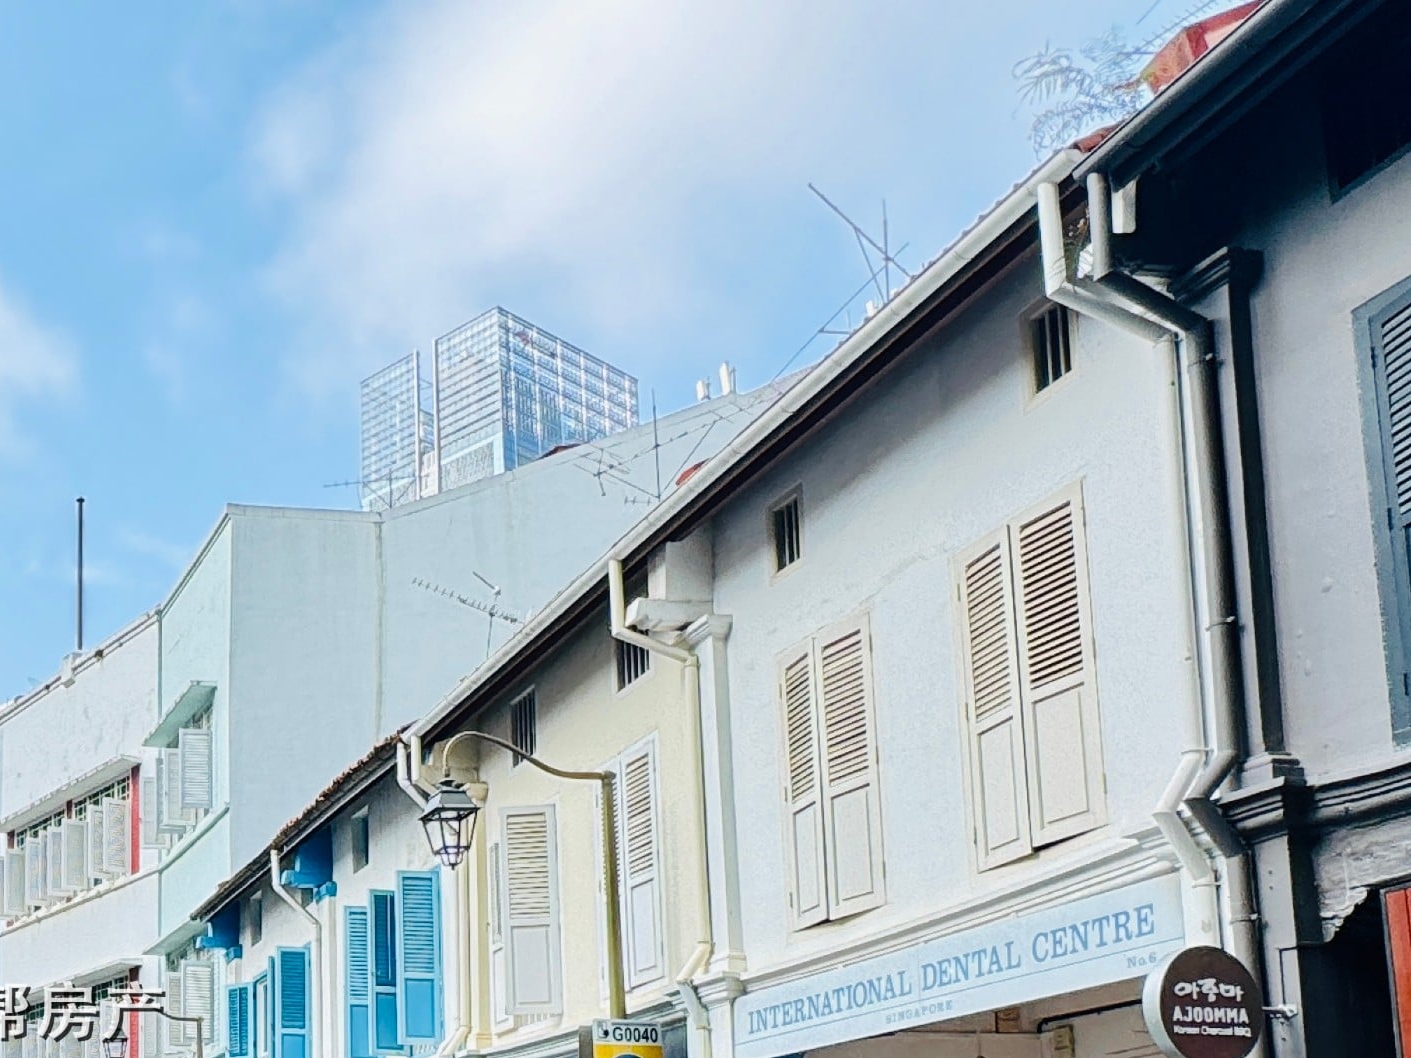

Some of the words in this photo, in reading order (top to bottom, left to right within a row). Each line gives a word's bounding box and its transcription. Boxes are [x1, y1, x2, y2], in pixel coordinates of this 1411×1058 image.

[748, 970, 912, 1035] INTERNATIONAL
[920, 940, 1021, 992] DENTAL
[1032, 903, 1155, 963] CENTRE
[1174, 977, 1244, 1002] 아줌마
[886, 999, 952, 1024] SINGAPORE
[1173, 1005, 1249, 1024] AJOOMMA
[612, 1026, 659, 1043] G0040
